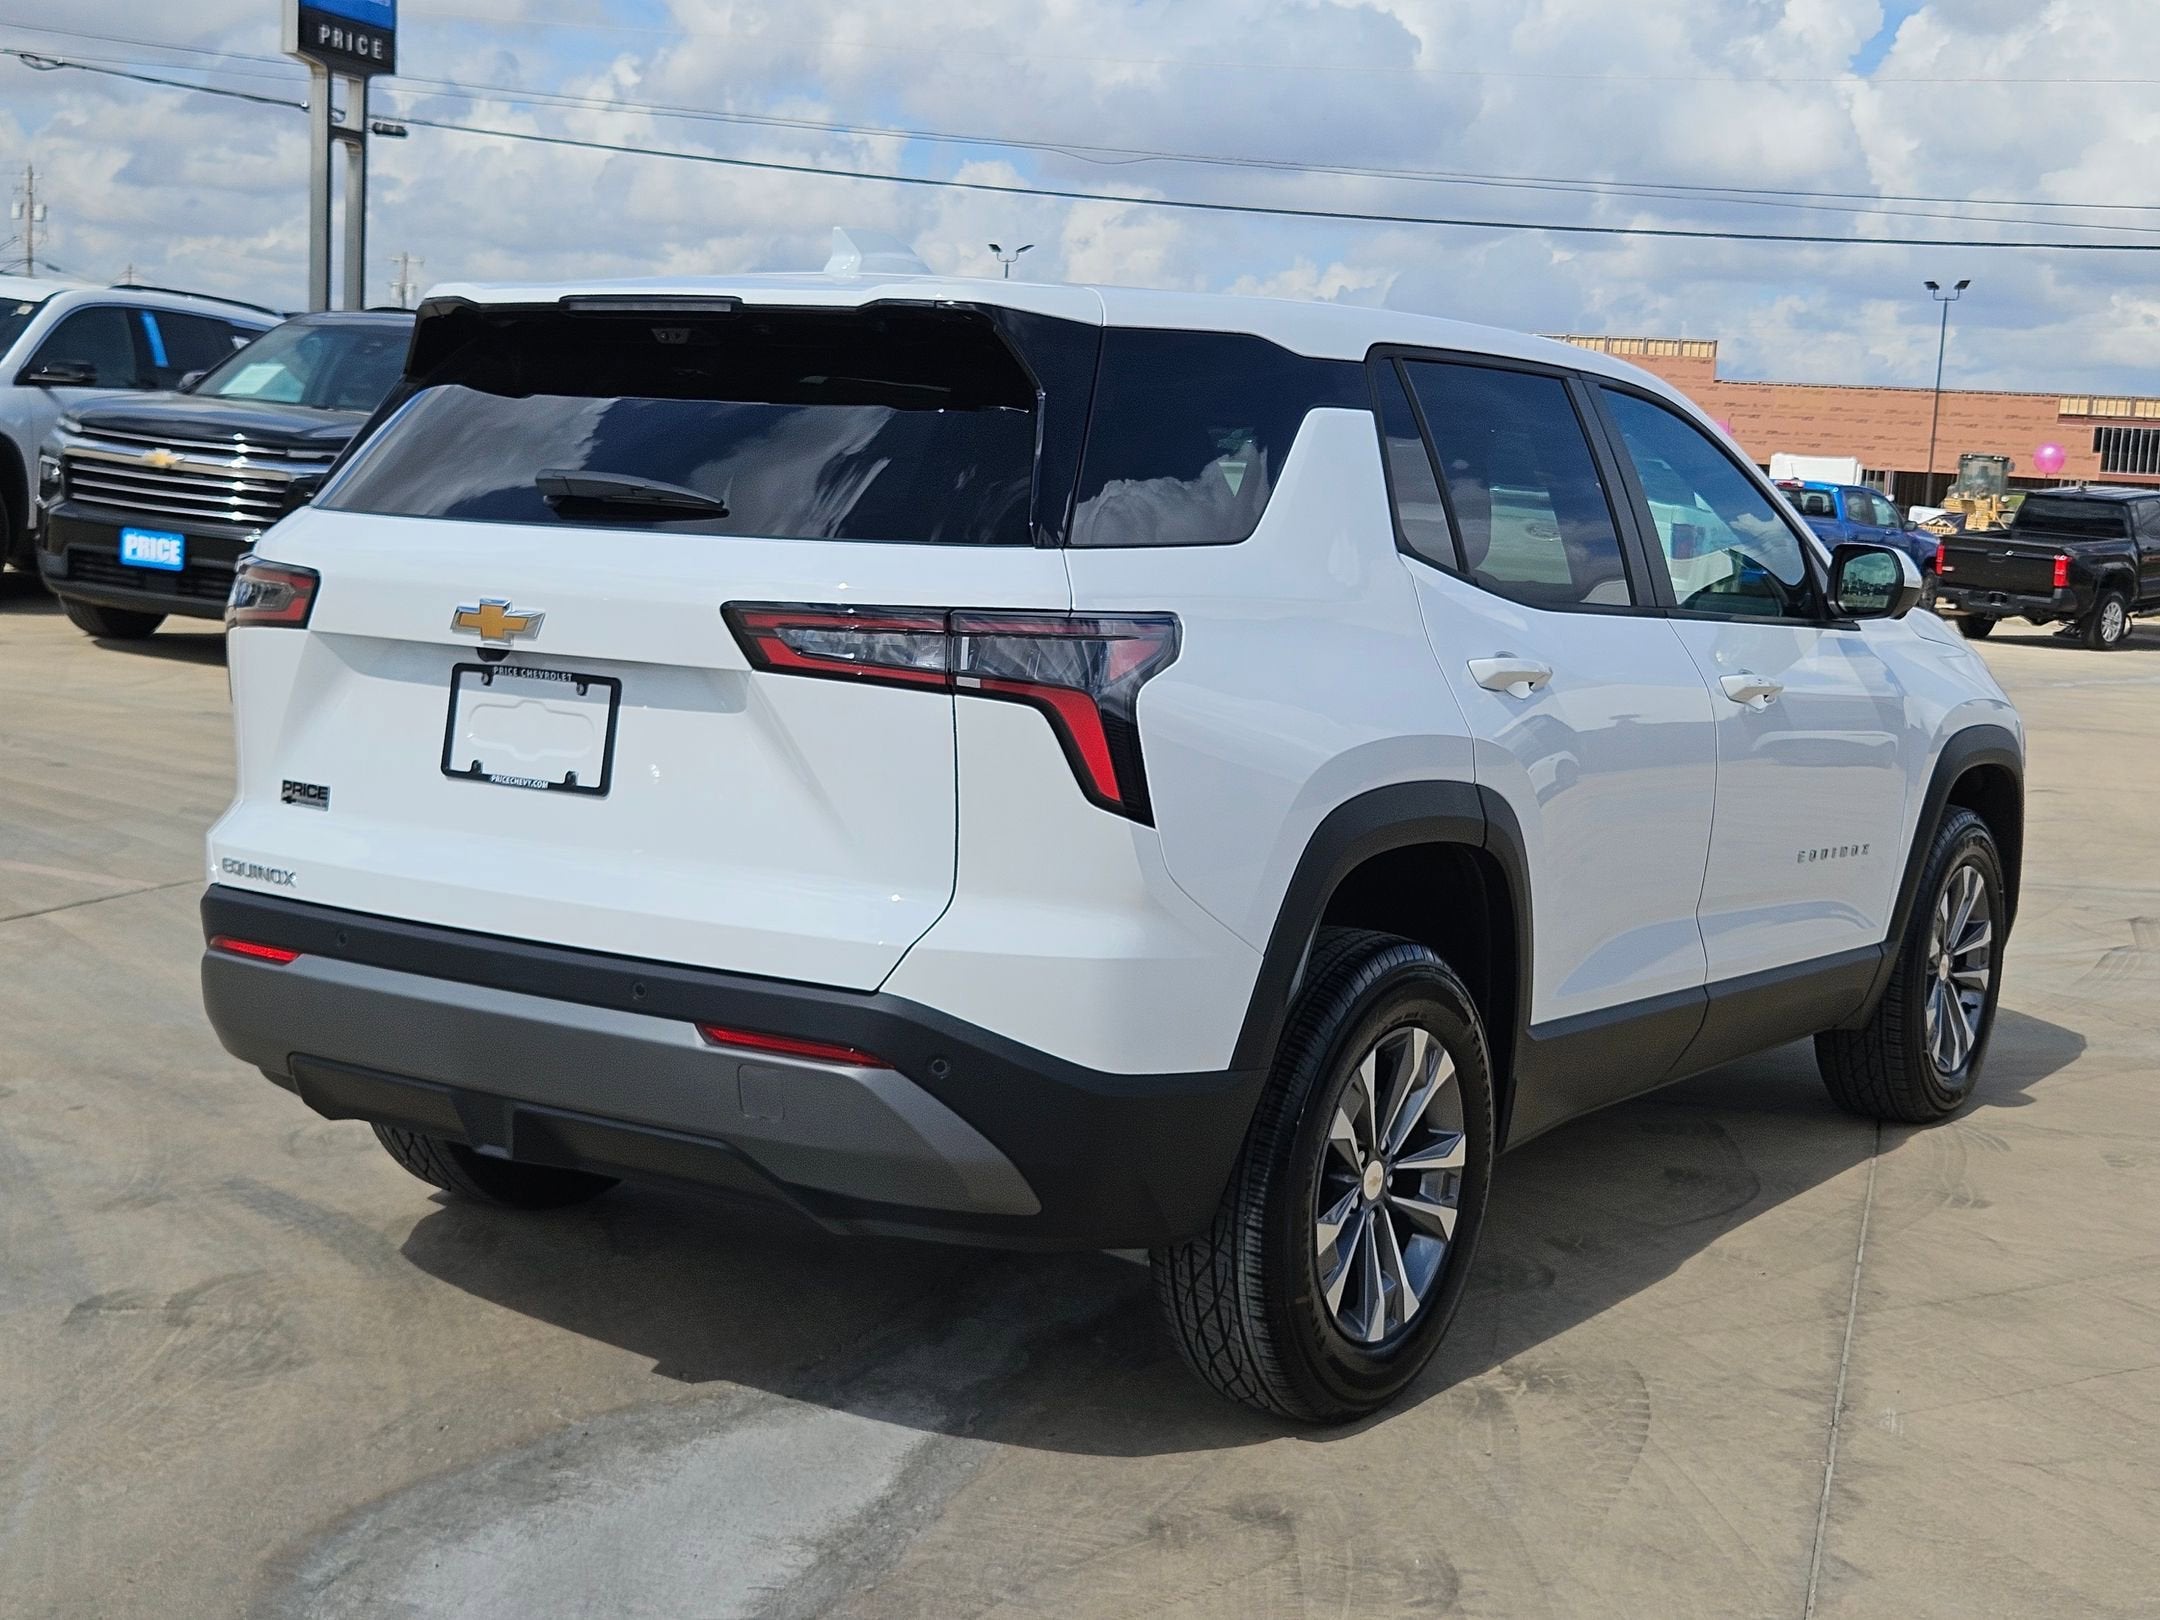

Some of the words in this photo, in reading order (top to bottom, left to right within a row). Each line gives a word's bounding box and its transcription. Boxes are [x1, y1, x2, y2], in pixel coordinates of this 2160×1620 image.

[318, 24, 383, 60] PRICE
[124, 533, 182, 566] PRICE
[493, 665, 518, 677] PRICE
[520, 668, 573, 682] CHEVROLET
[281, 779, 329, 801] PRICE
[1797, 843, 1871, 864] EQUINOX
[221, 857, 296, 888] EQUINOX
